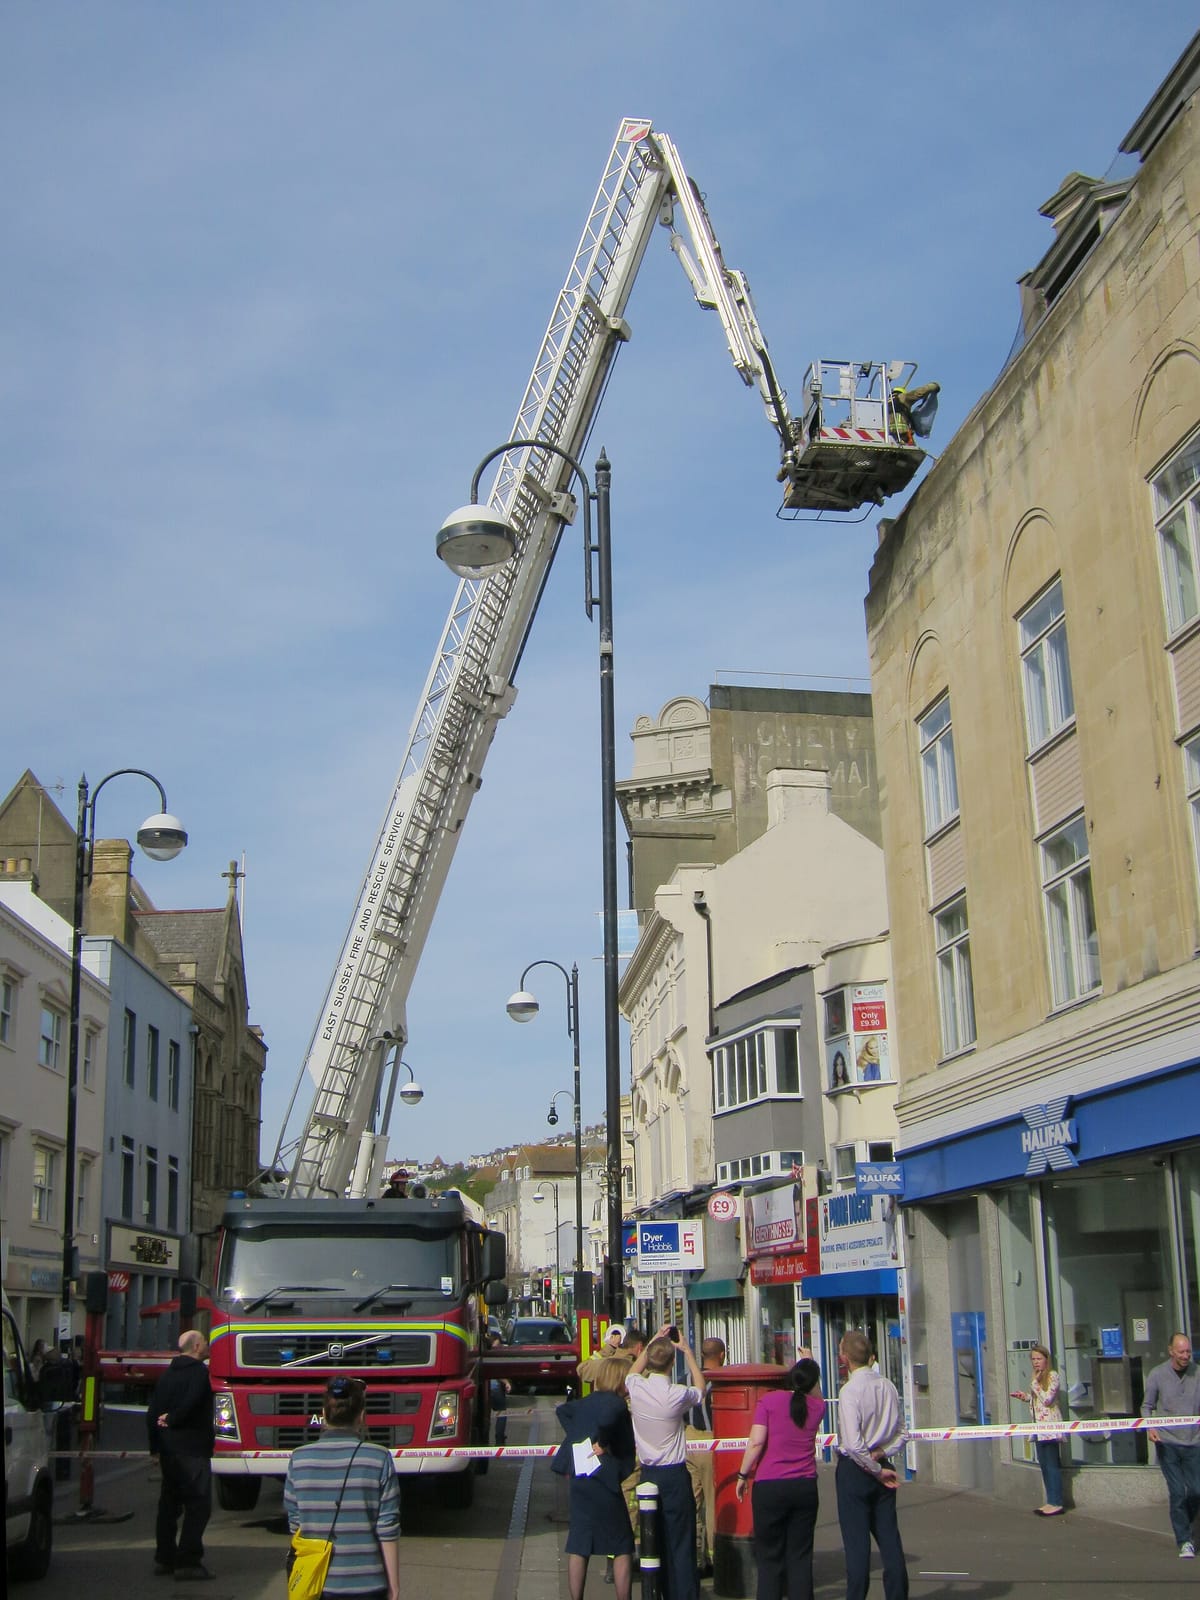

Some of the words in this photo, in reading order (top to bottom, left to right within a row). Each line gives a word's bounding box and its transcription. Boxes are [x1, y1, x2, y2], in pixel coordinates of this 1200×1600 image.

[323, 1011, 338, 1041] EAST
[333, 963, 354, 1008] SUSSEX
[349, 935, 364, 959] FIRE
[360, 908, 372, 931] AND
[367, 860, 389, 904] RESCUE
[383, 810, 405, 856] SERVICE
[861, 1011, 878, 1020] Only
[1021, 1120, 1072, 1153] HALIFAX
[859, 1174, 901, 1183] HALIFAX
[713, 1200, 729, 1213] £9
[642, 1232, 663, 1243] Dyer
[683, 1233, 695, 1255] LET
[310, 1414, 324, 1425] Ar
